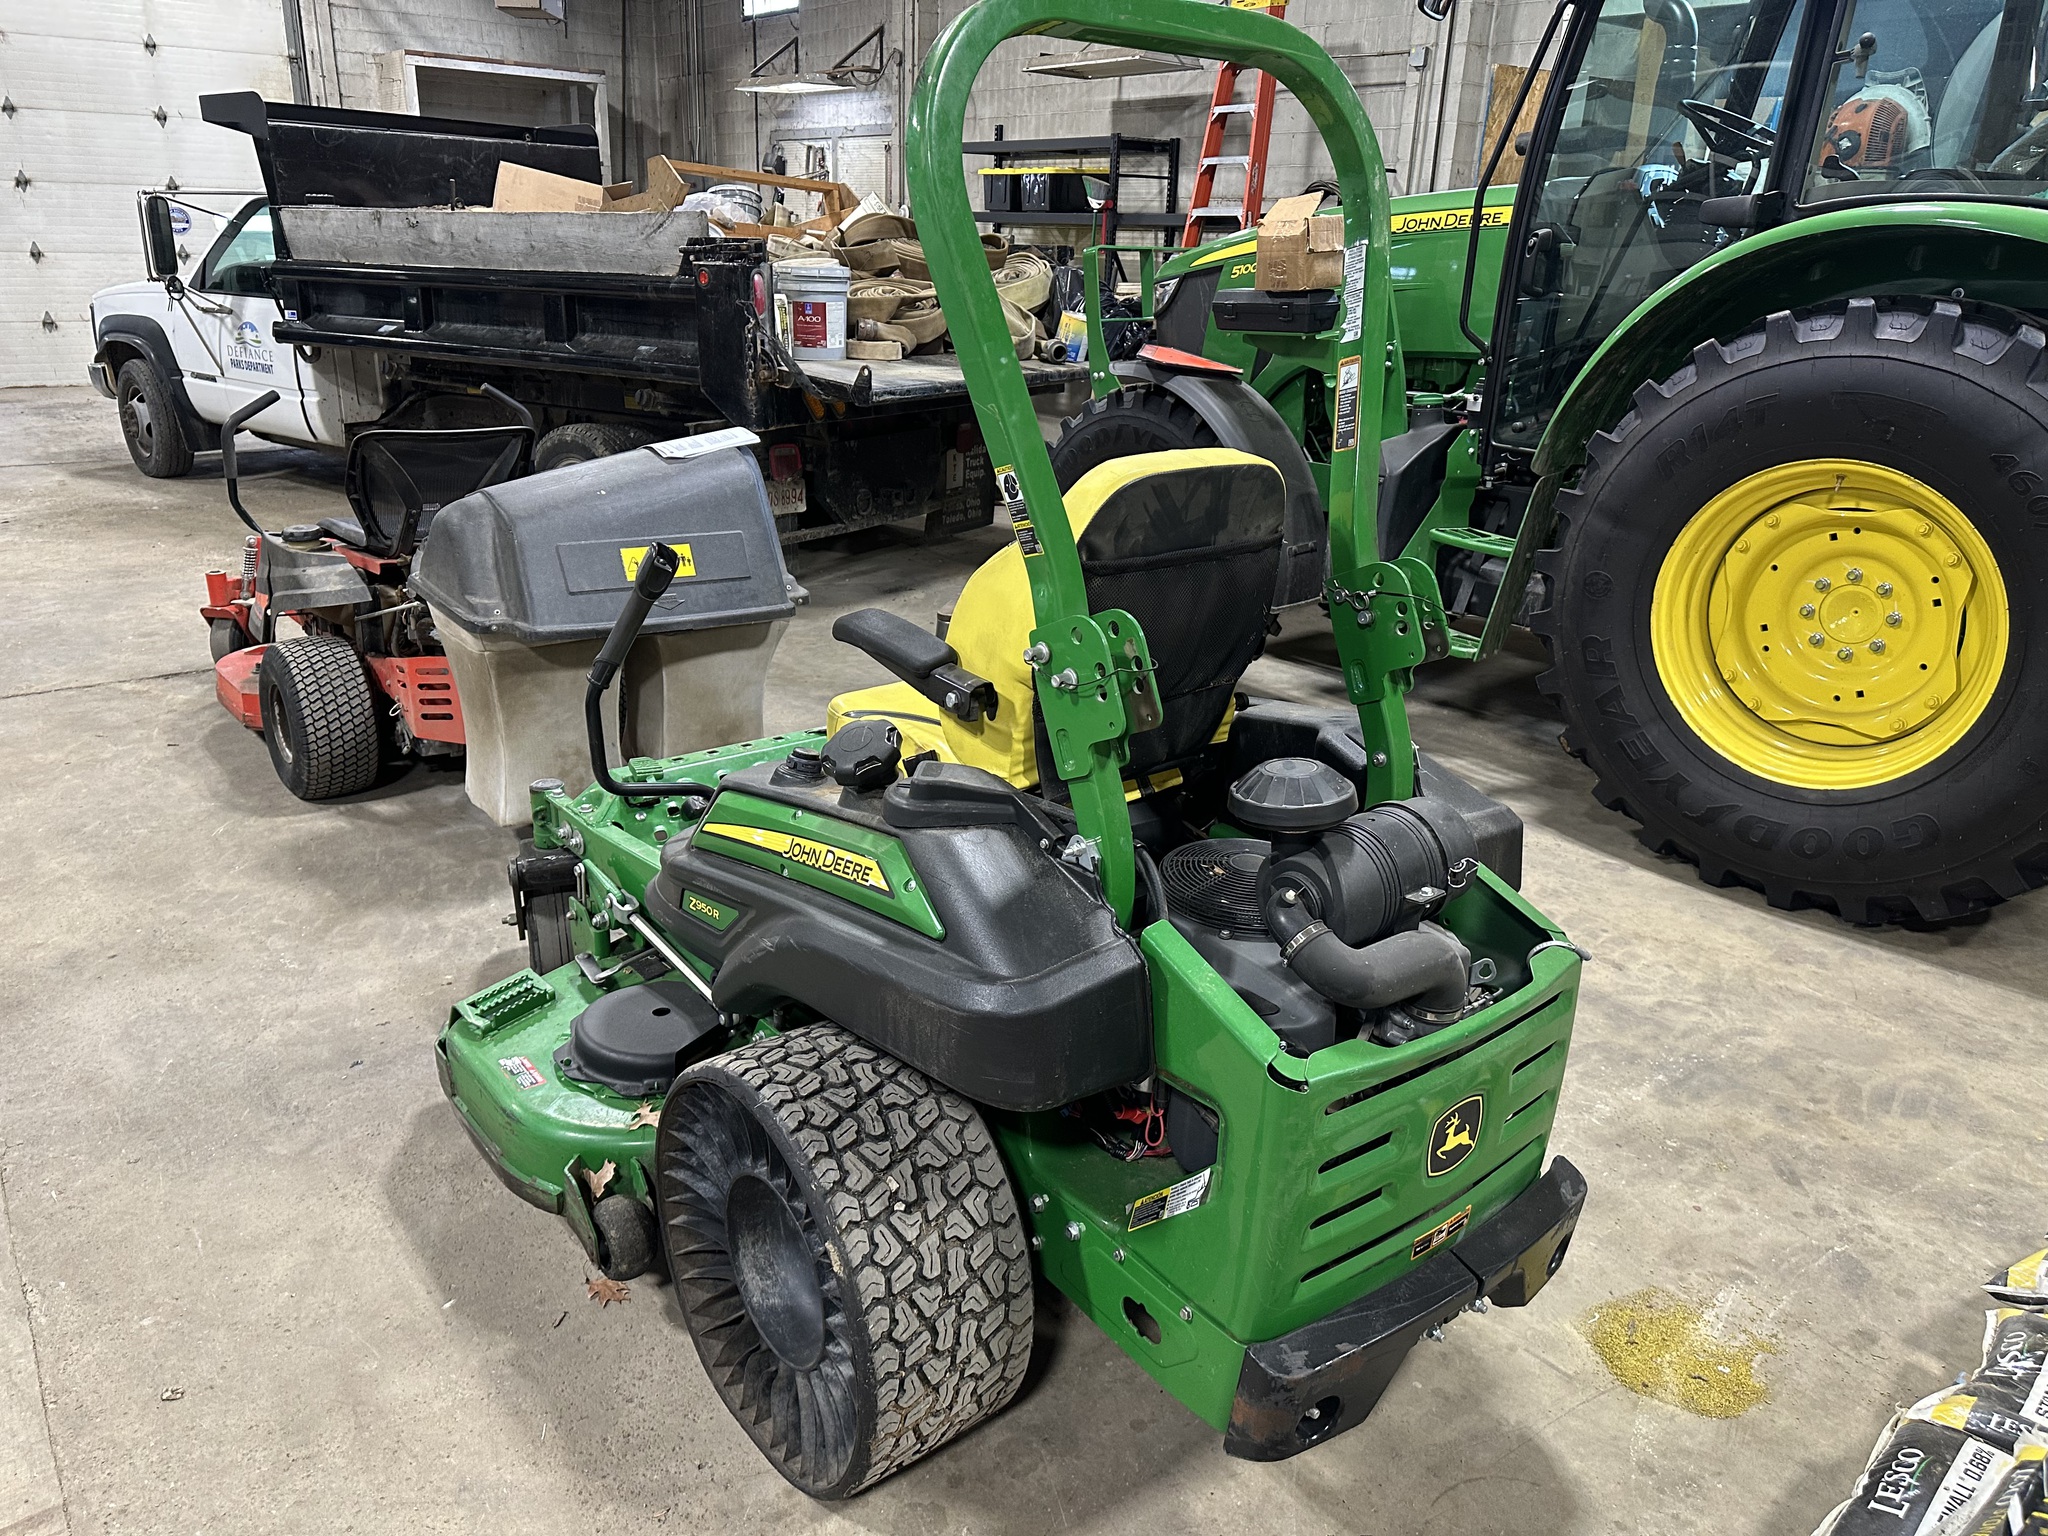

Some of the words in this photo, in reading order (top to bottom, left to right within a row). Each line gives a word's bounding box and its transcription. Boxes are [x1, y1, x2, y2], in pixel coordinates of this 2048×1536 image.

[1396, 217, 1443, 231] JOHN
[226, 345, 275, 363] DEFIANCE
[230, 358, 245, 370] PARKS
[244, 360, 274, 375] DEPARTMENT
[966, 456, 984, 468] Truck
[1581, 634, 1941, 861] GOODYEAR
[784, 838, 822, 868] JOHN
[821, 850, 874, 884] DEERE
[1962, 1445, 1996, 1482] 0.68%
[1867, 1447, 1926, 1520] LESCO
